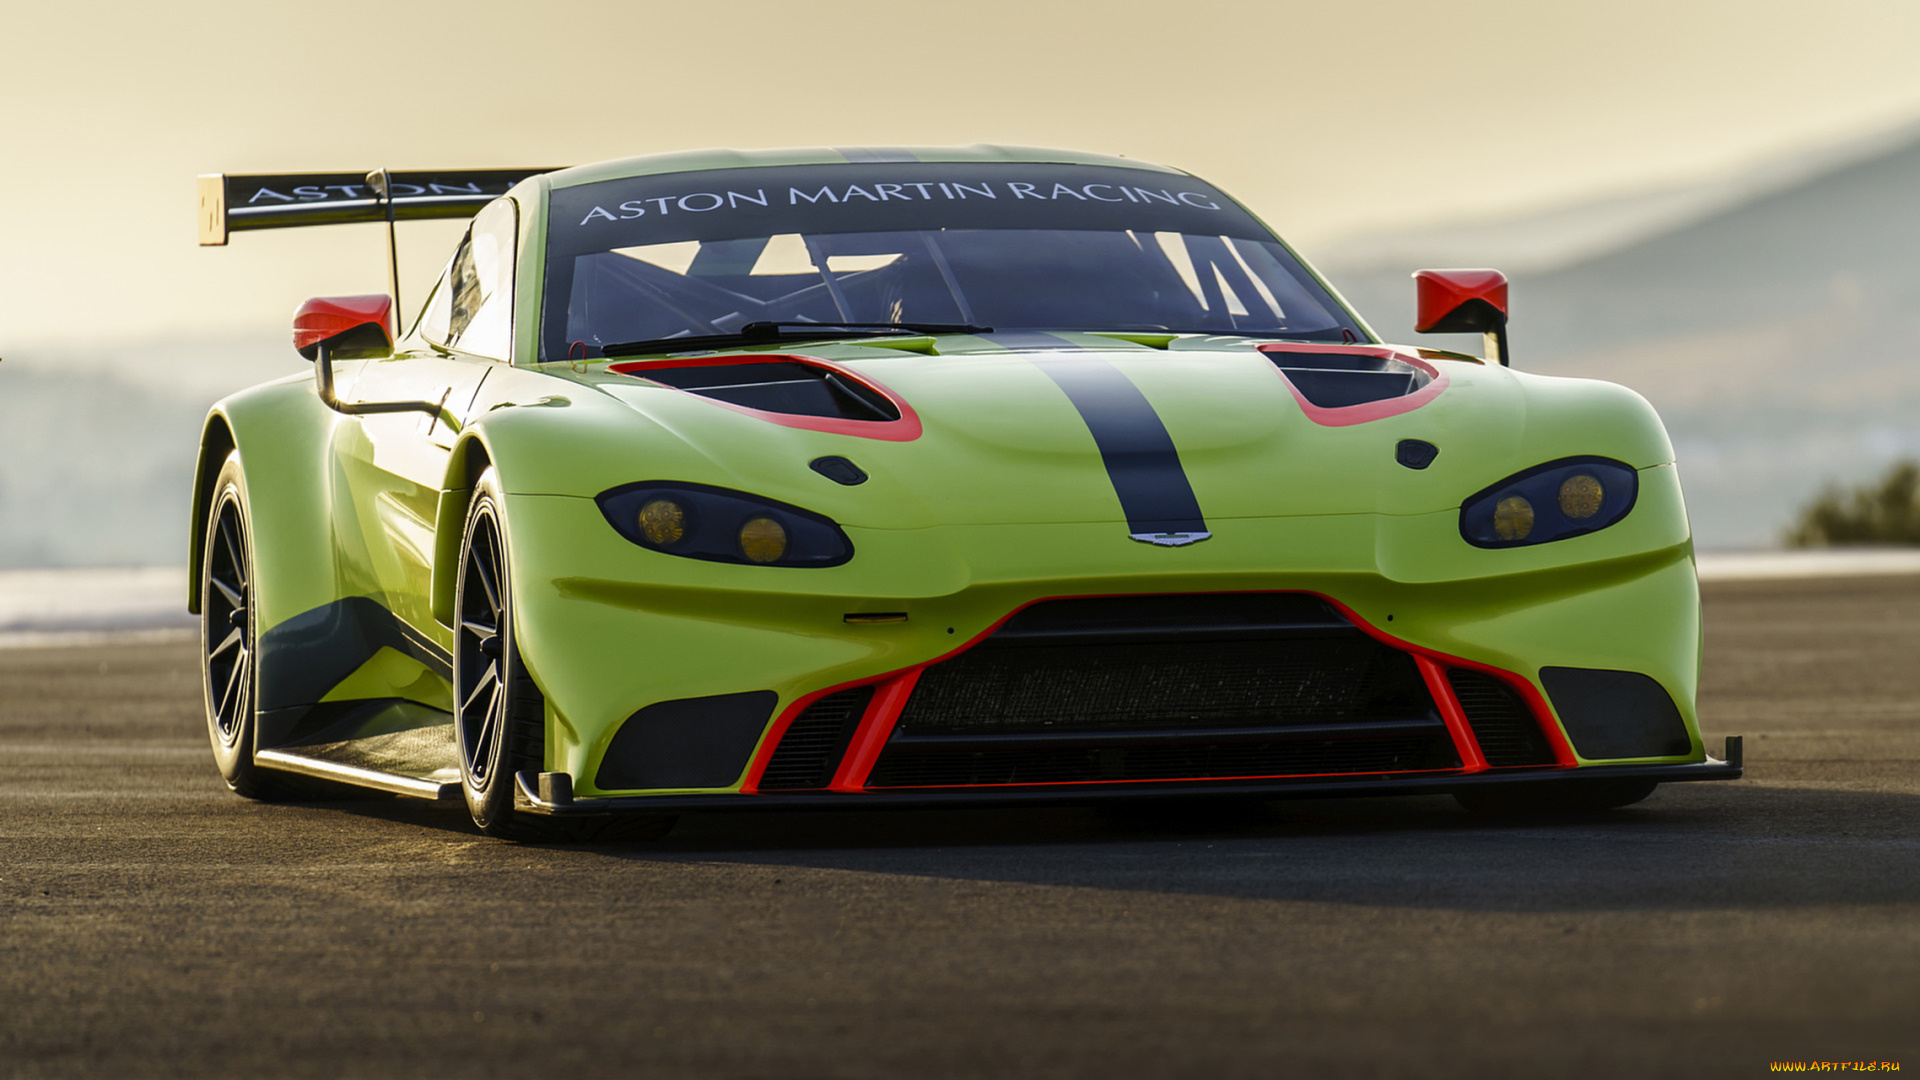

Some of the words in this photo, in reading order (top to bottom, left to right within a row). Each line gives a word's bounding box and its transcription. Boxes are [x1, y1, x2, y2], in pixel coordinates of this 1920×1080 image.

[580, 189, 768, 226] ASTON
[789, 181, 997, 205] MARTIN
[1006, 182, 1221, 210] RACING
